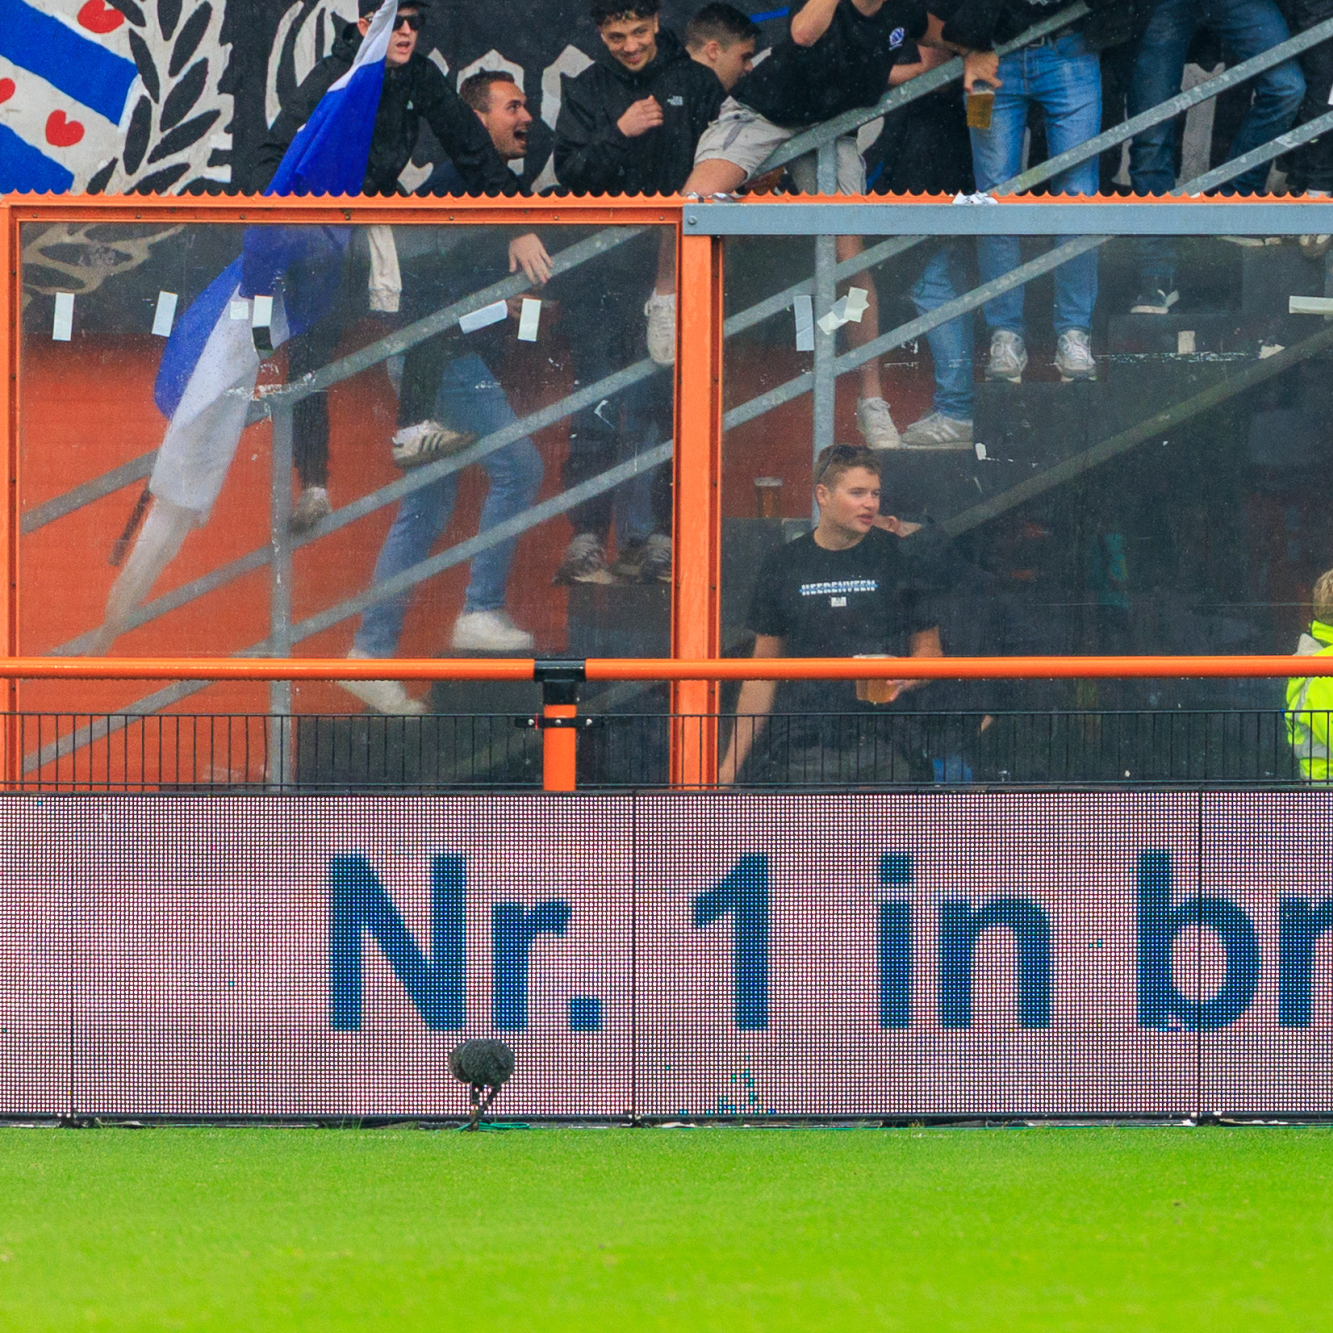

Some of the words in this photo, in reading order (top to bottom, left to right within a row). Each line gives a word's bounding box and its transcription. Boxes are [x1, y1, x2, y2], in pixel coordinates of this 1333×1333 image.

[330, 852, 601, 1030] Nr.
[693, 853, 769, 1029] 1
[879, 853, 1052, 1028] in
